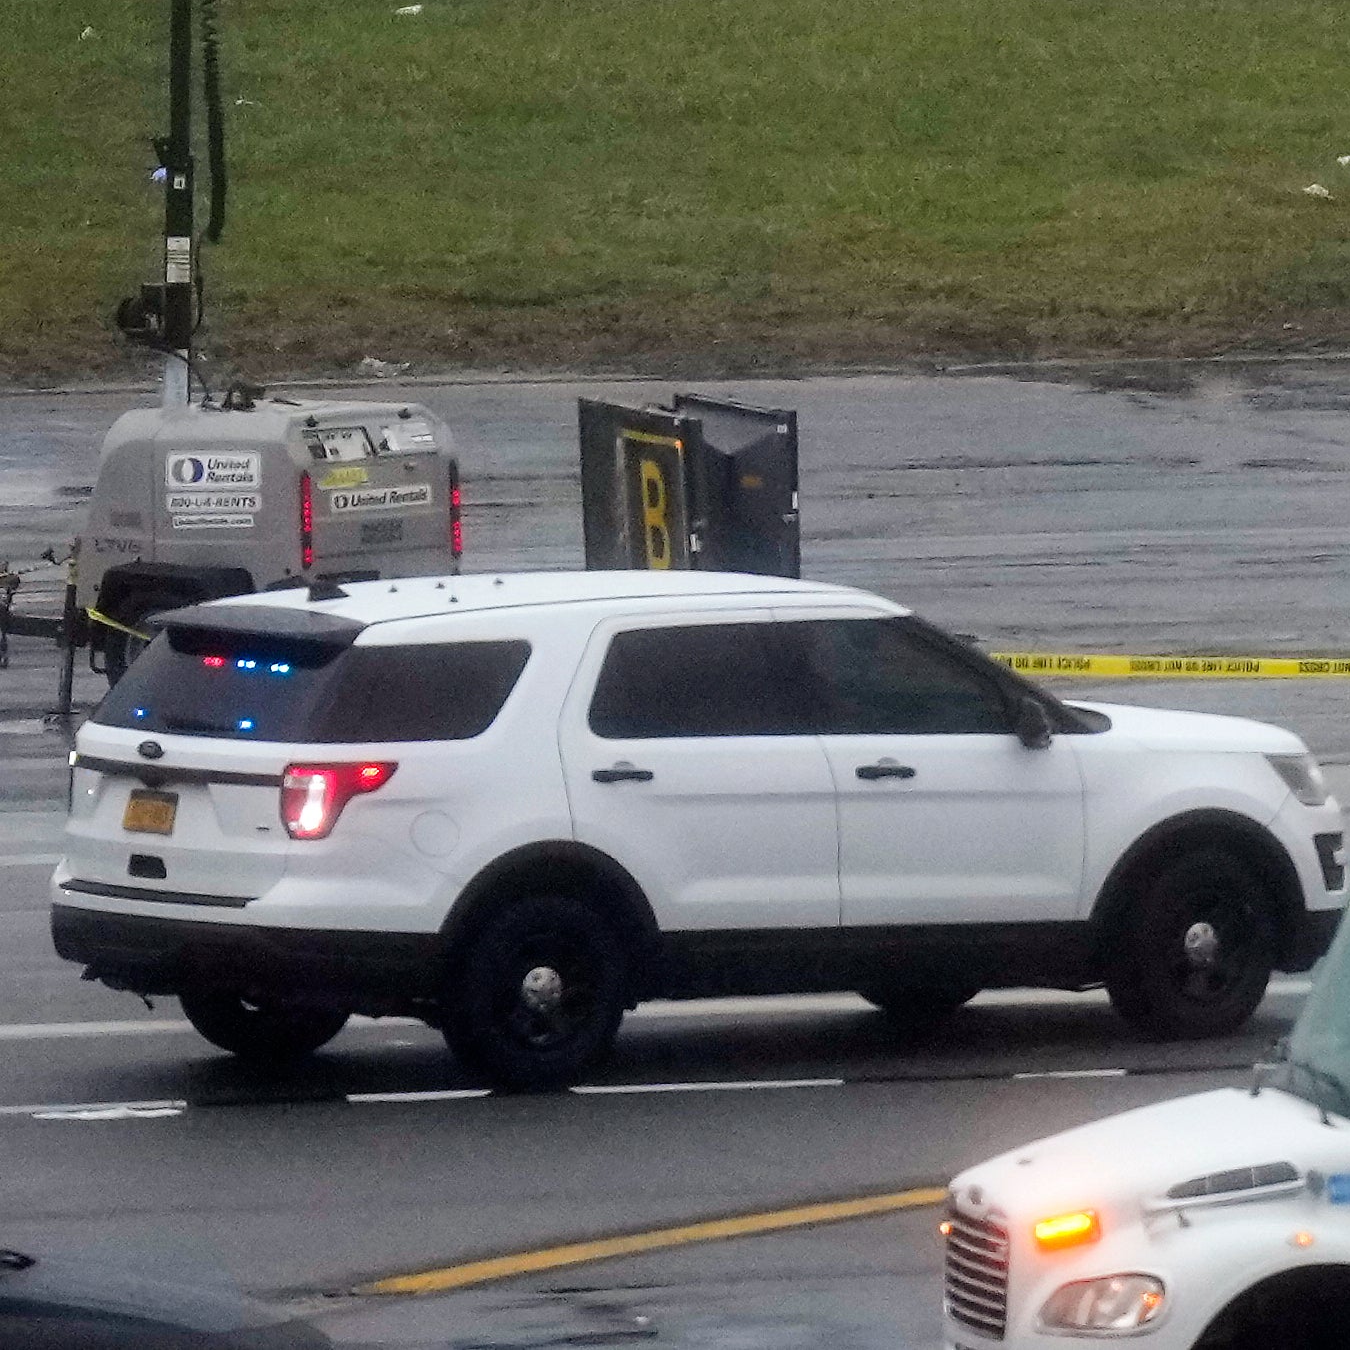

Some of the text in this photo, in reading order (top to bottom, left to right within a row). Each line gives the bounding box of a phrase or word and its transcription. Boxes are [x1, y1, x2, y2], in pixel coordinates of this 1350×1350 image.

[207, 458, 250, 470] United
[206, 471, 254, 483] Rentals
[351, 492, 387, 507] United
[640, 459, 672, 570] B
